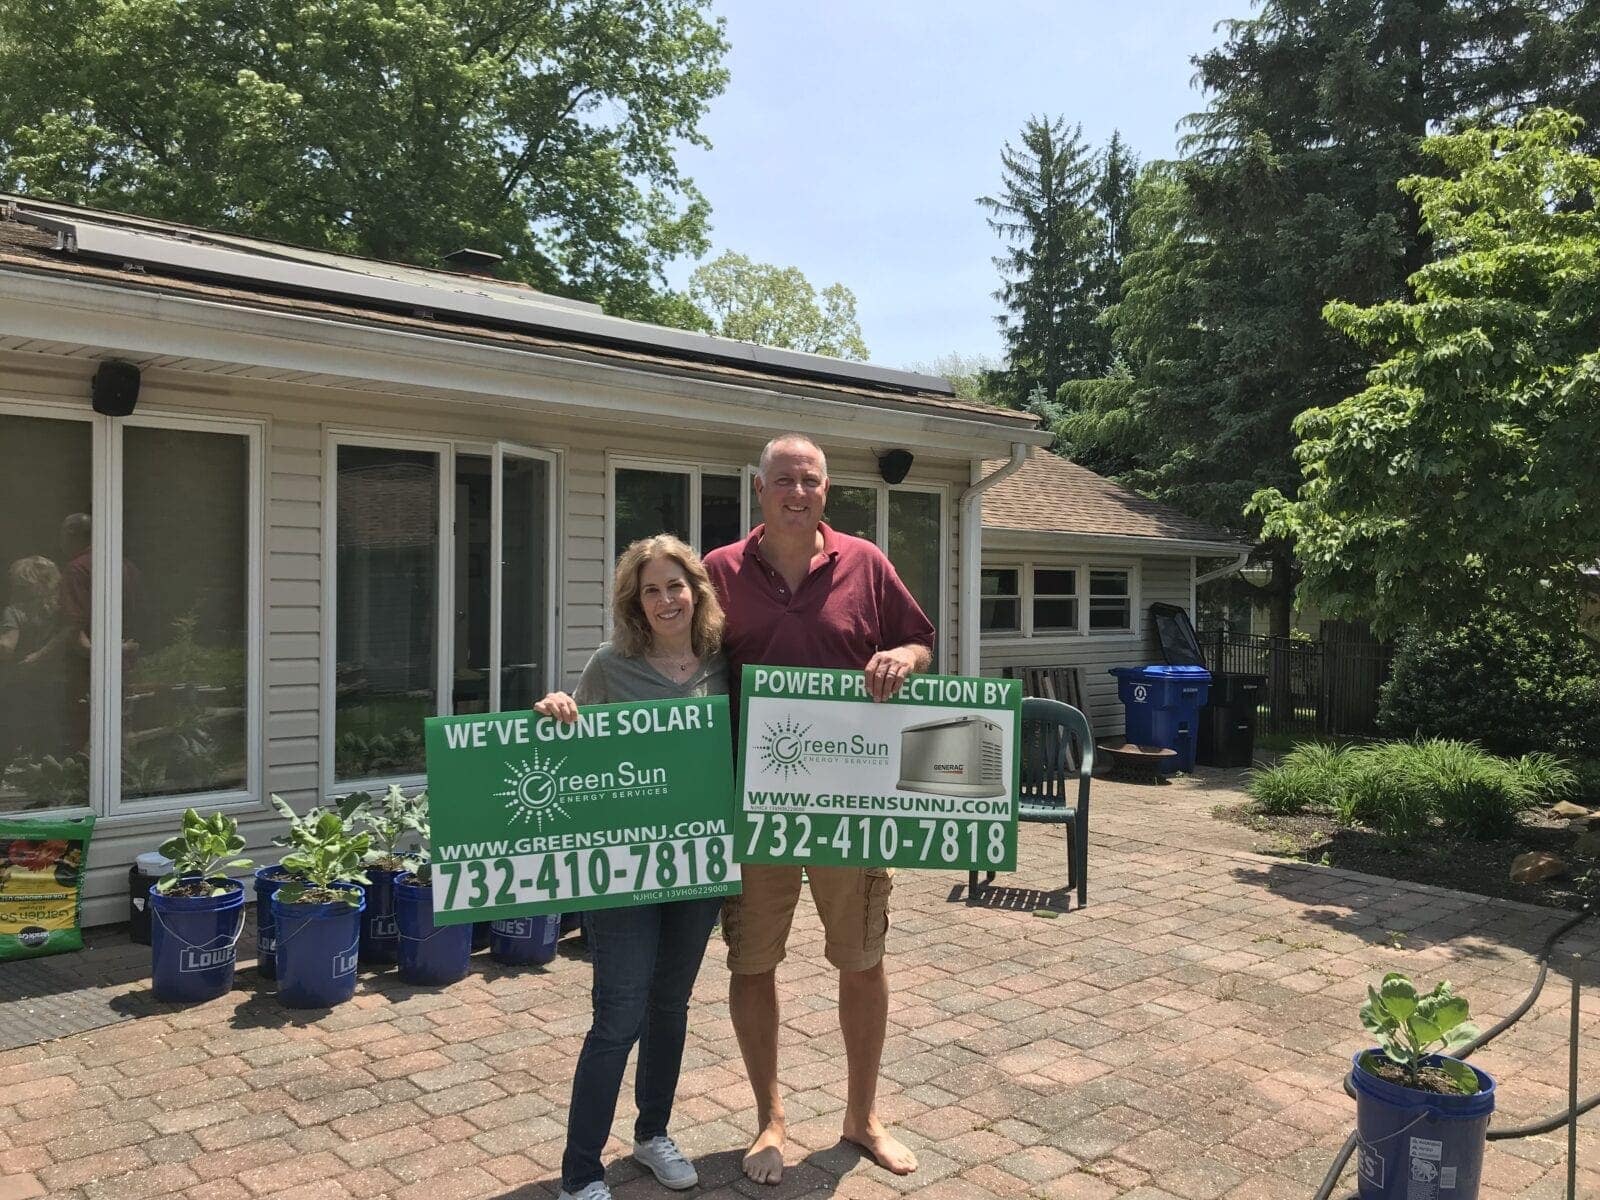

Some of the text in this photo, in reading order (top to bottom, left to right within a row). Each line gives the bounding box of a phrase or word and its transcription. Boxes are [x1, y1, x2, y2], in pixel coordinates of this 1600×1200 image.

[755, 669, 1012, 705] POWER PRECTION BY
[444, 717, 530, 750] WE'VE
[536, 711, 611, 742] GONE
[803, 756, 889, 766] ENERGY SERVICES
[559, 787, 668, 805] ENERGY SERVICES
[748, 790, 1010, 816] WWW.GREENSUNNJ.COM
[438, 819, 727, 862] WWW.GREENSUNNJ.COM
[746, 813, 1006, 864] 732-410-7818
[439, 836, 728, 911] 732-410-7818
[19, 910, 69, 922] Garden
